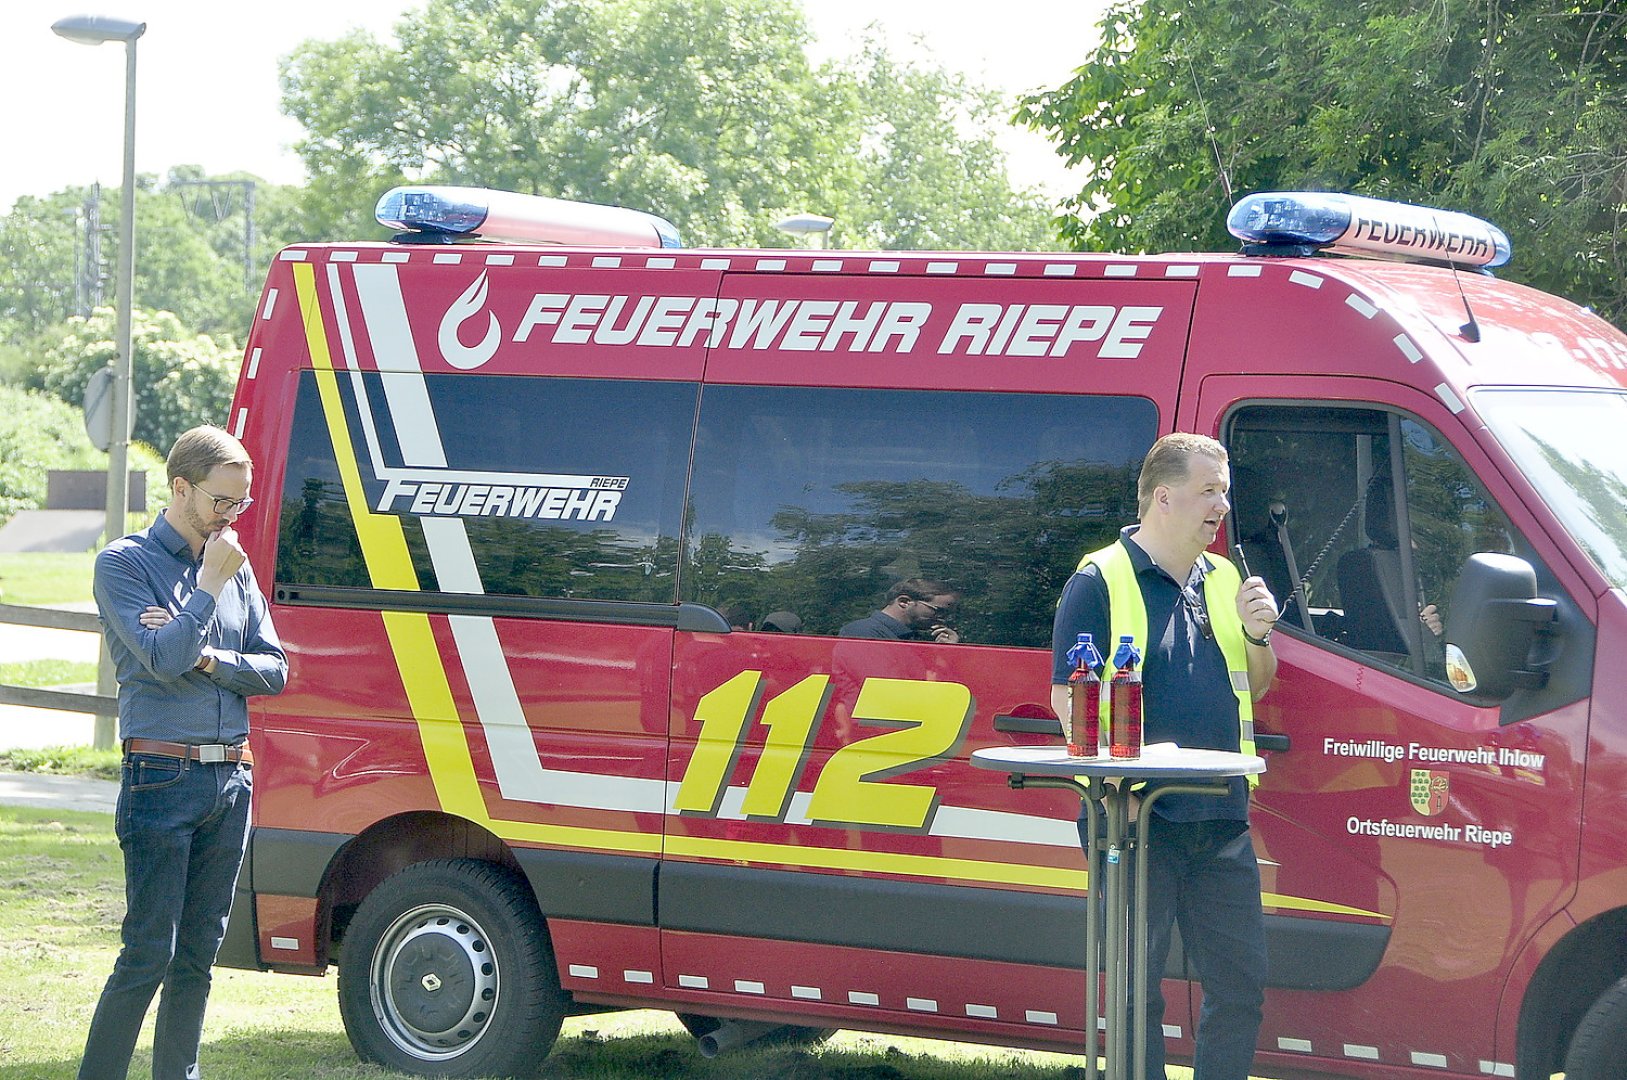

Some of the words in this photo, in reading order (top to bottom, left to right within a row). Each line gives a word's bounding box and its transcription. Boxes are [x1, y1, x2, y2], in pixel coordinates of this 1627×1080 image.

[1354, 217, 1488, 257] FEUERWEHR
[512, 293, 933, 354] FEUERWEHR
[936, 302, 1163, 359] RIEPE
[376, 477, 622, 522] FEUERWEHR
[589, 477, 627, 489] RIEPE
[673, 669, 973, 830] 112
[1323, 738, 1404, 762] Freiwillige
[1409, 743, 1495, 764] Feuerwehr
[1499, 747, 1545, 768] Ihlow
[1346, 816, 1462, 841] Ortsfeuerwehr
[1465, 825, 1512, 848] Riepe
